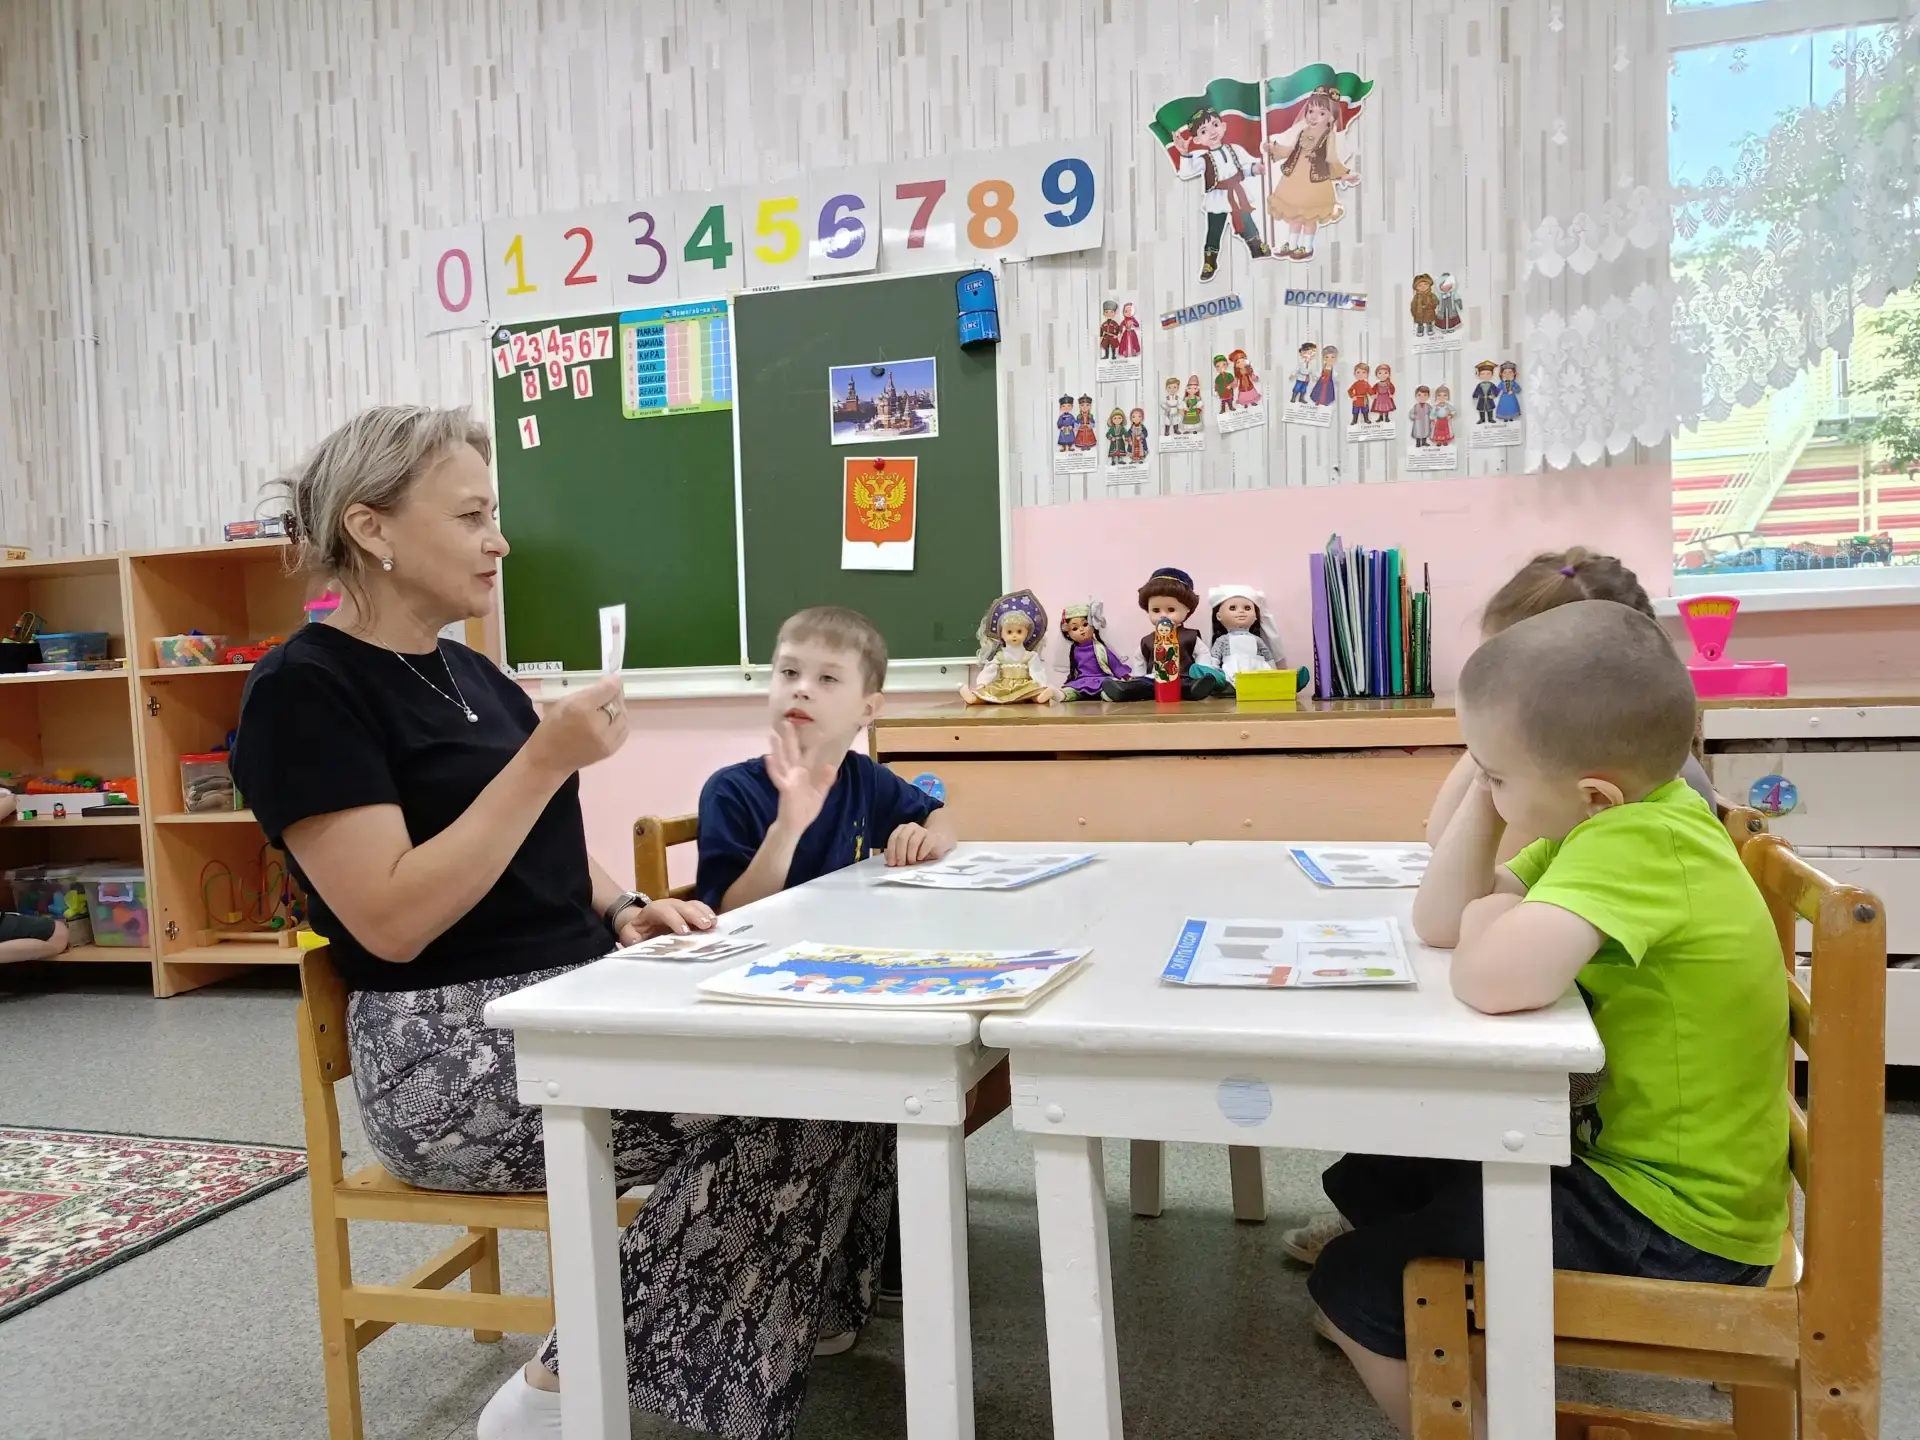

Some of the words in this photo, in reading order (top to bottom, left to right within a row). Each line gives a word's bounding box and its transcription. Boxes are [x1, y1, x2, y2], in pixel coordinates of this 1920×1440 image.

[437, 248, 472, 312] 0
[503, 234, 537, 296] 1
[563, 226, 598, 286] 2
[627, 211, 668, 285] 3
[683, 204, 733, 270] 4
[753, 196, 802, 265] 5
[817, 193, 867, 260] 6
[895, 179, 947, 249] 7
[967, 179, 1019, 249] 8
[1041, 158, 1096, 228] 9
[967, 280, 983, 291] LINC
[1176, 295, 1242, 325] НАРОДЫ
[1285, 290, 1350, 307] РОССИИ
[962, 321, 978, 331] LINC
[498, 348, 510, 374] 1
[513, 335, 528, 363] 2
[528, 336, 542, 364] 3
[547, 329, 560, 356] 4
[561, 335, 574, 363] 5
[579, 330, 592, 359] 6
[597, 329, 609, 357] 7
[639, 350, 660, 360] КИРА
[640, 363, 657, 372] МАРК
[524, 370, 538, 399] 8
[549, 360, 563, 388] 9
[576, 368, 589, 397] 0
[640, 399, 658, 407] УМАР
[523, 418, 535, 446] 1
[519, 662, 561, 672] ДОСКА
[921, 779, 936, 795] 7
[1762, 782, 1782, 812] 4
